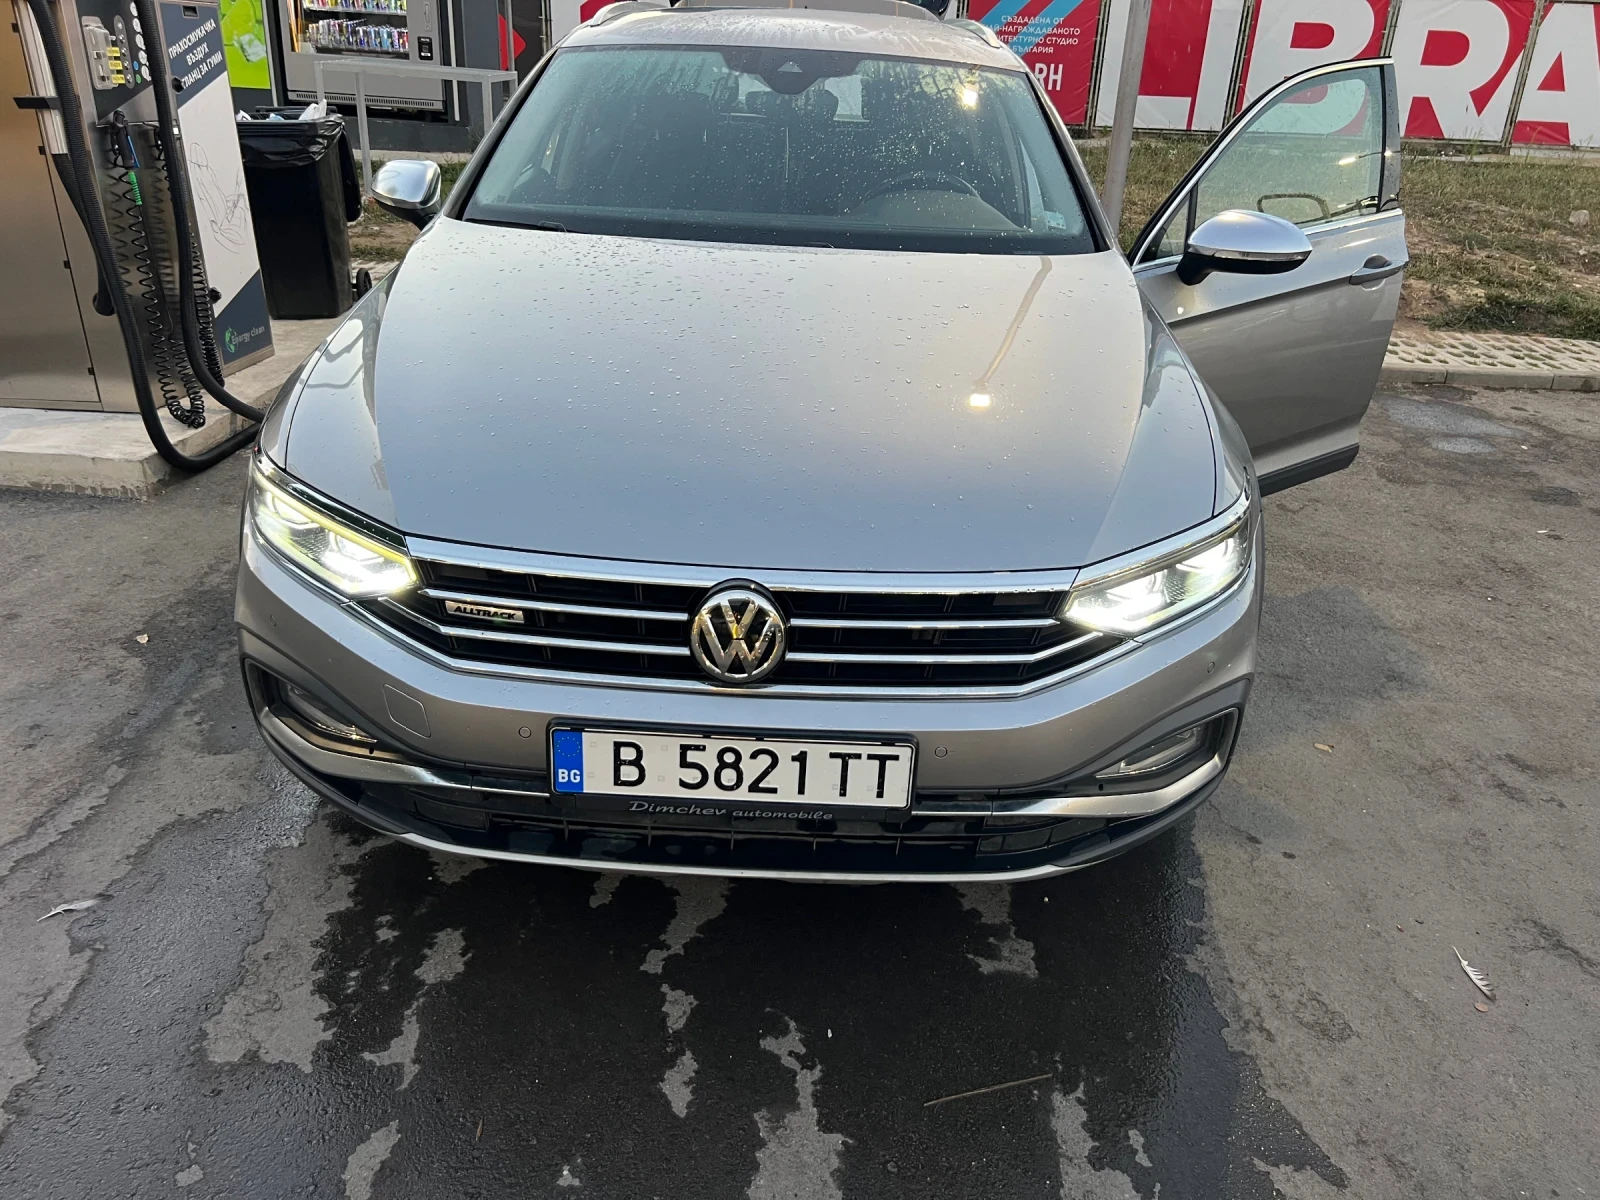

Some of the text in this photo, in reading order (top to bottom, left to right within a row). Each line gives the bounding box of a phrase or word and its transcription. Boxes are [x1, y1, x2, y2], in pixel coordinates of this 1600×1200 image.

[1001, 15, 1064, 25] СЪЗДАДЕНА ОТ
[168, 18, 216, 59] ПРАХОСМУКАЧКА
[997, 35, 1079, 45] ИТЕКТУРНО СТУДИО
[186, 42, 209, 66] ВЪЗДУХ
[1012, 45, 1054, 54] БЪЛГАРИЯ
[200, 62, 209, 76] ЗА
[206, 50, 223, 69] ГУМИ
[1095, 0, 1600, 147] LIBRA
[454, 605, 516, 620] ALLTRACK
[558, 769, 580, 783] BG
[613, 741, 900, 799] B 5821 TT
[629, 800, 833, 820] Dimchev automobile
